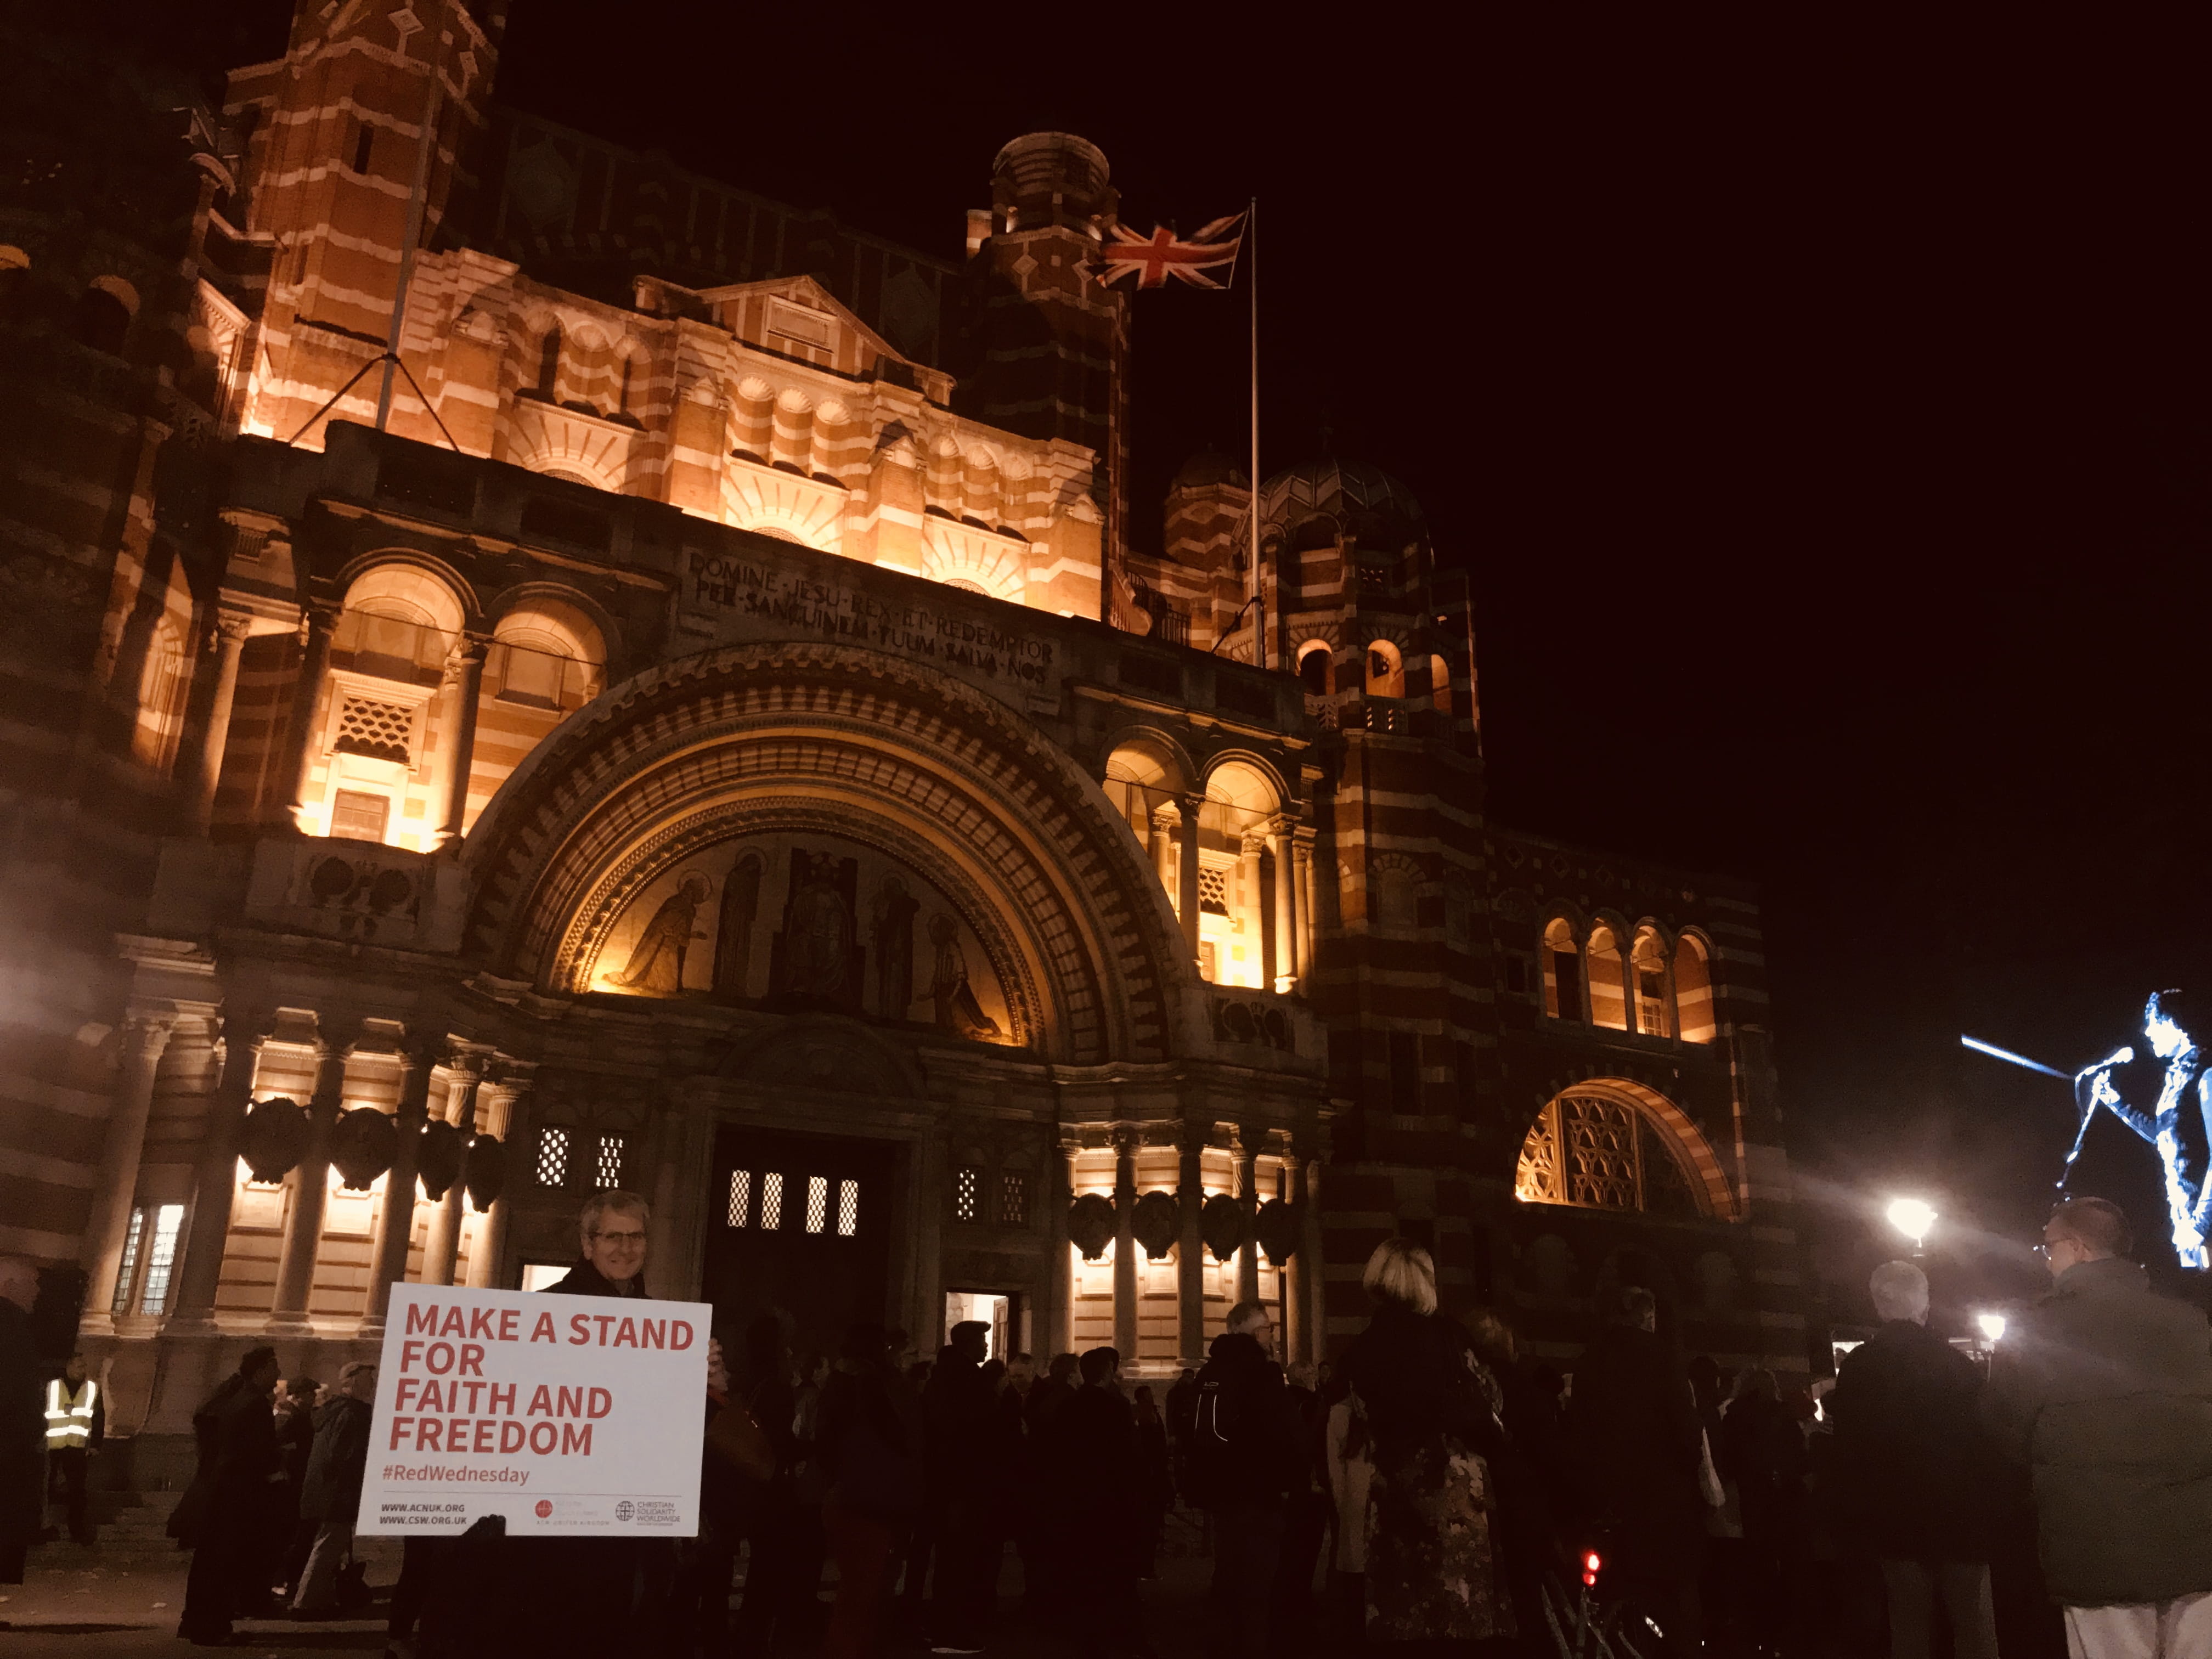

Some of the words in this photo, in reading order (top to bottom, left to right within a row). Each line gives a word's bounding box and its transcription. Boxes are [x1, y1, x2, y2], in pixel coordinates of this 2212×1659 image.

[690, 552, 778, 592] DOMINE
[787, 579, 840, 606] JESU
[852, 595, 891, 622] REX
[902, 608, 928, 629] ET
[936, 616, 1053, 662] REDEMPTOR
[696, 577, 736, 606] PER
[879, 625, 935, 656] TUUM
[1008, 658, 1046, 684] NOS
[405, 1303, 521, 1341] MAKE
[530, 1312, 556, 1343] A
[568, 1314, 693, 1351] STAND
[400, 1340, 485, 1376] FOR
[395, 1378, 517, 1415] FAITH
[527, 1385, 612, 1419] AND
[389, 1417, 593, 1456] FREEDOM
[382, 1464, 529, 1486] #RedWednesday
[379, 1516, 467, 1525] WWW.CSW.ORG.UK
[381, 1504, 465, 1513] WWW.ACNUK.ORG
